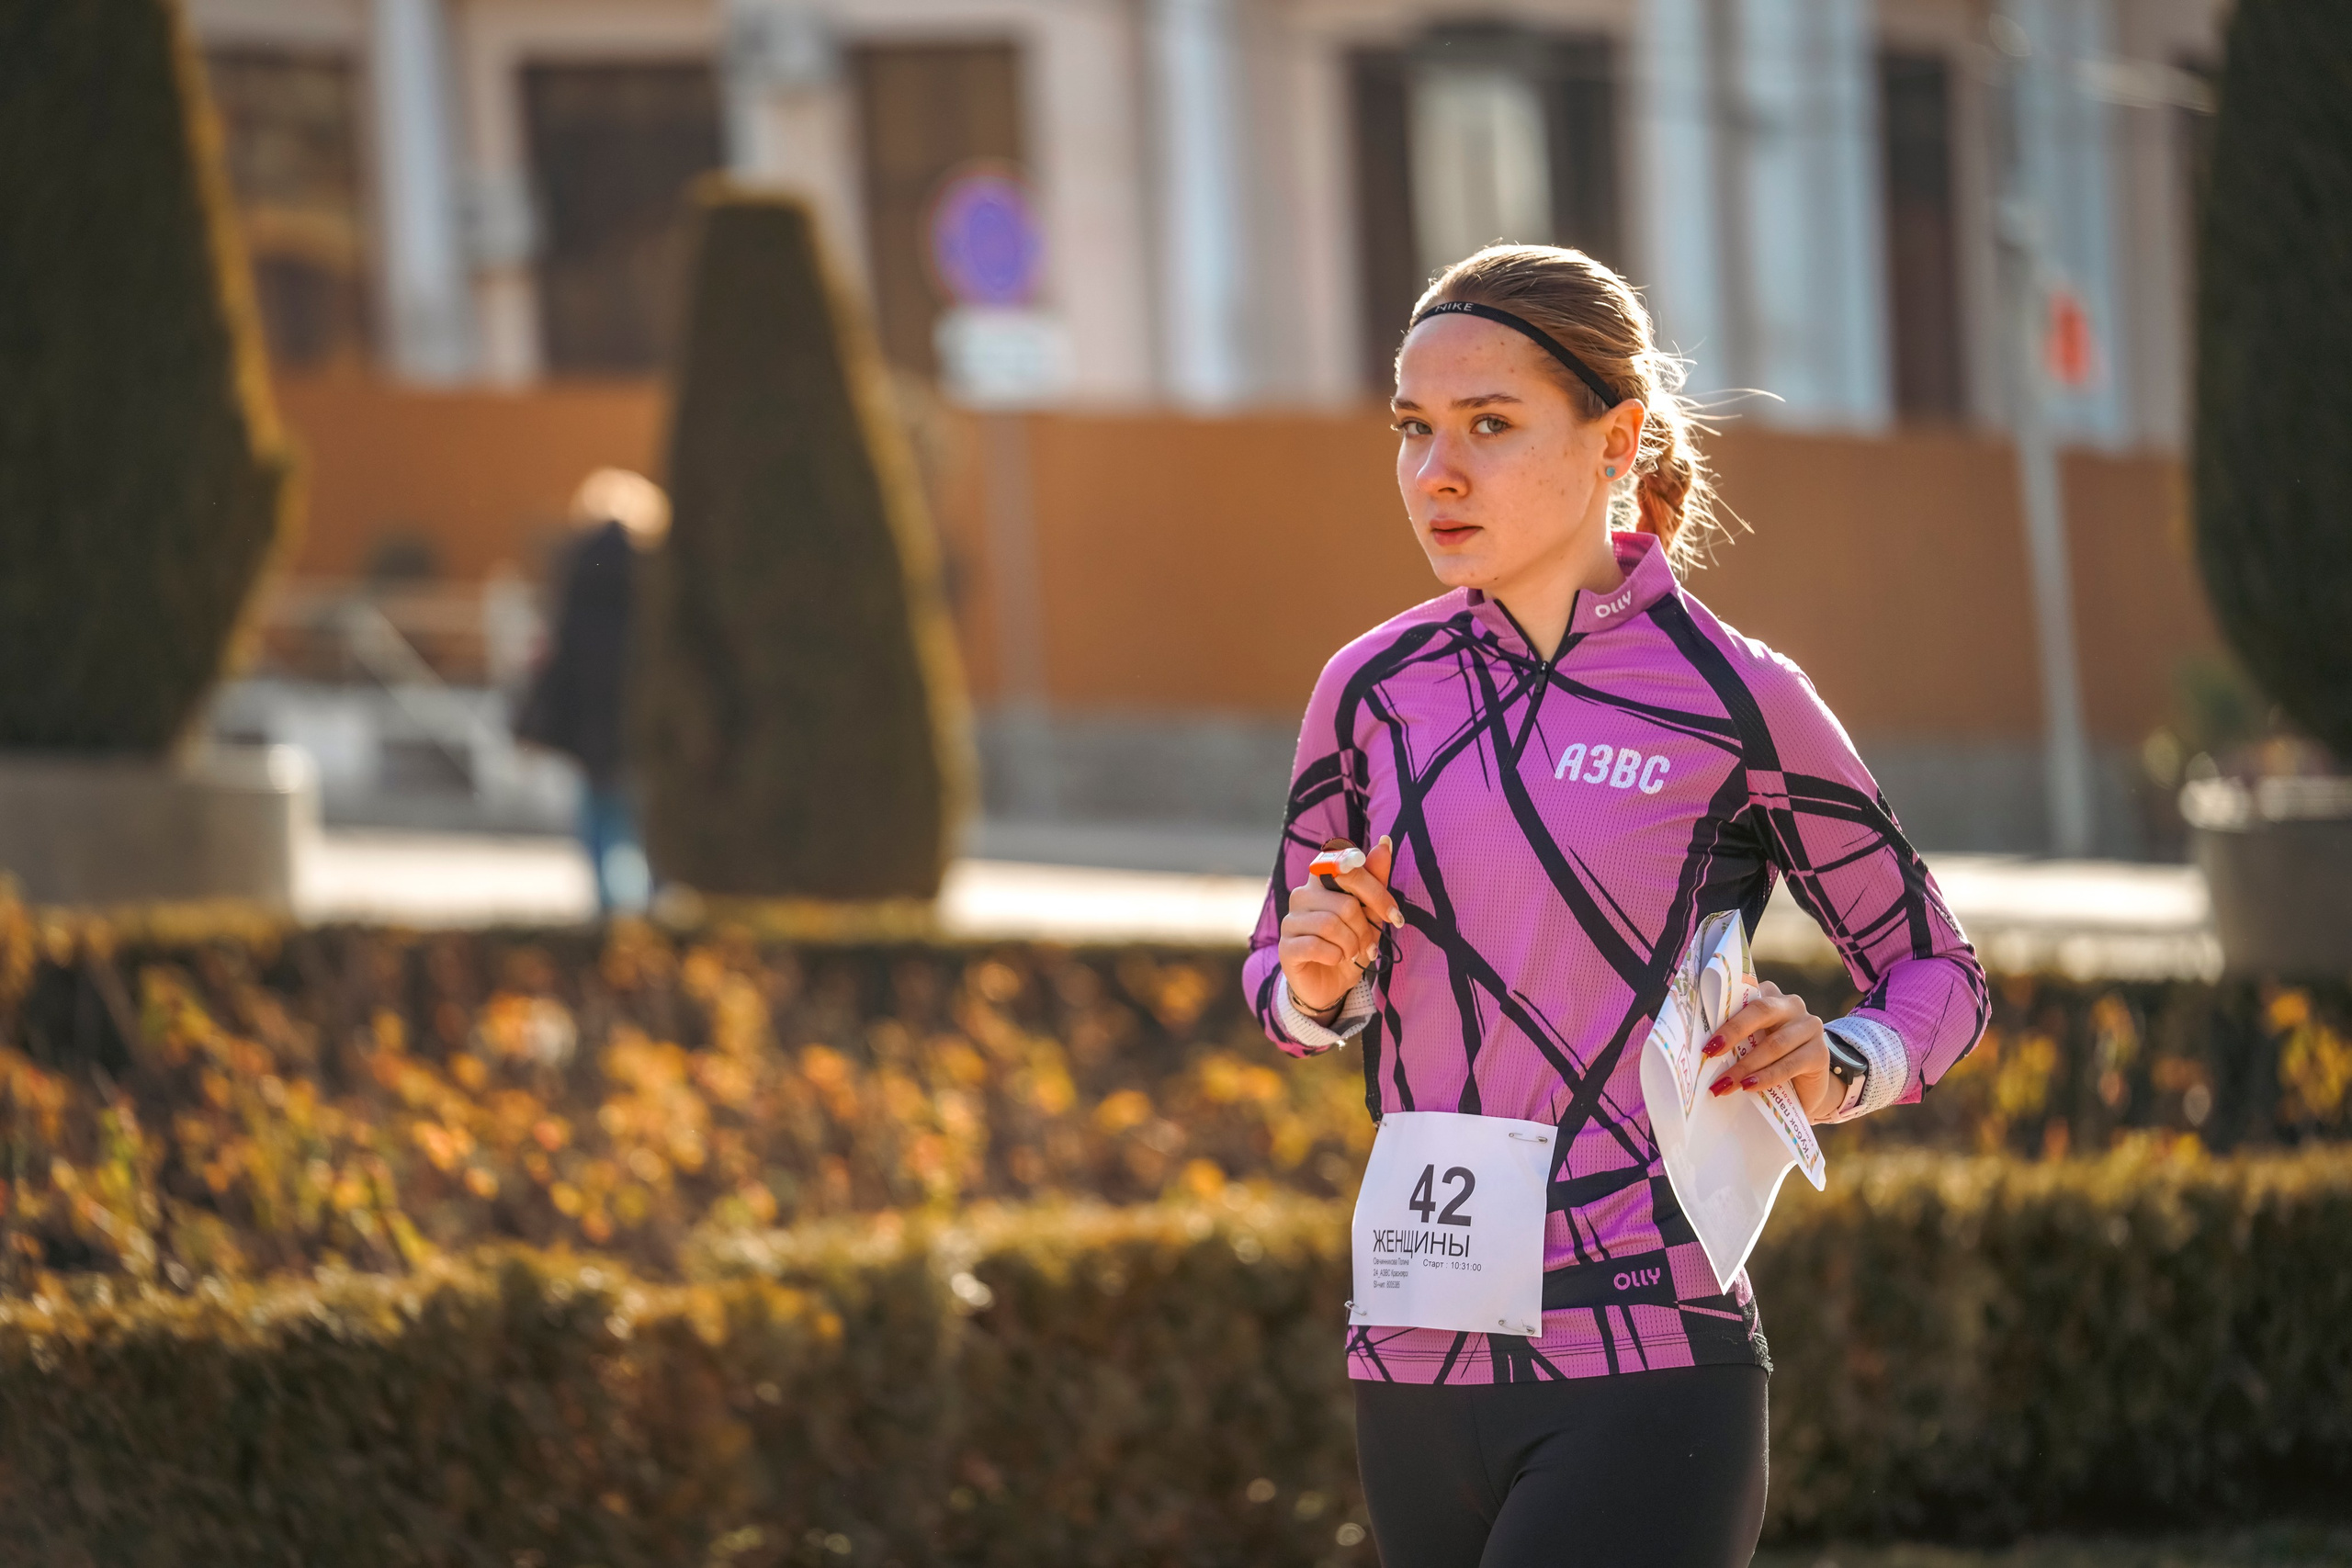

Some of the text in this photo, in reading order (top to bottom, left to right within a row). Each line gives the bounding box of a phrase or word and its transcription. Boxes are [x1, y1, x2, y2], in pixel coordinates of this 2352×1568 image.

[1435, 302, 1474, 312] NIKE
[1594, 590, 1632, 618] OLLY
[1408, 1164, 1476, 1226] 42
[1373, 1230, 1470, 1258] ЖЕНЩИНЫ
[1422, 1258, 1443, 1269] Старт
[1451, 1261, 1482, 1271] 10:31:00
[1613, 1267, 1661, 1291] OLLY
